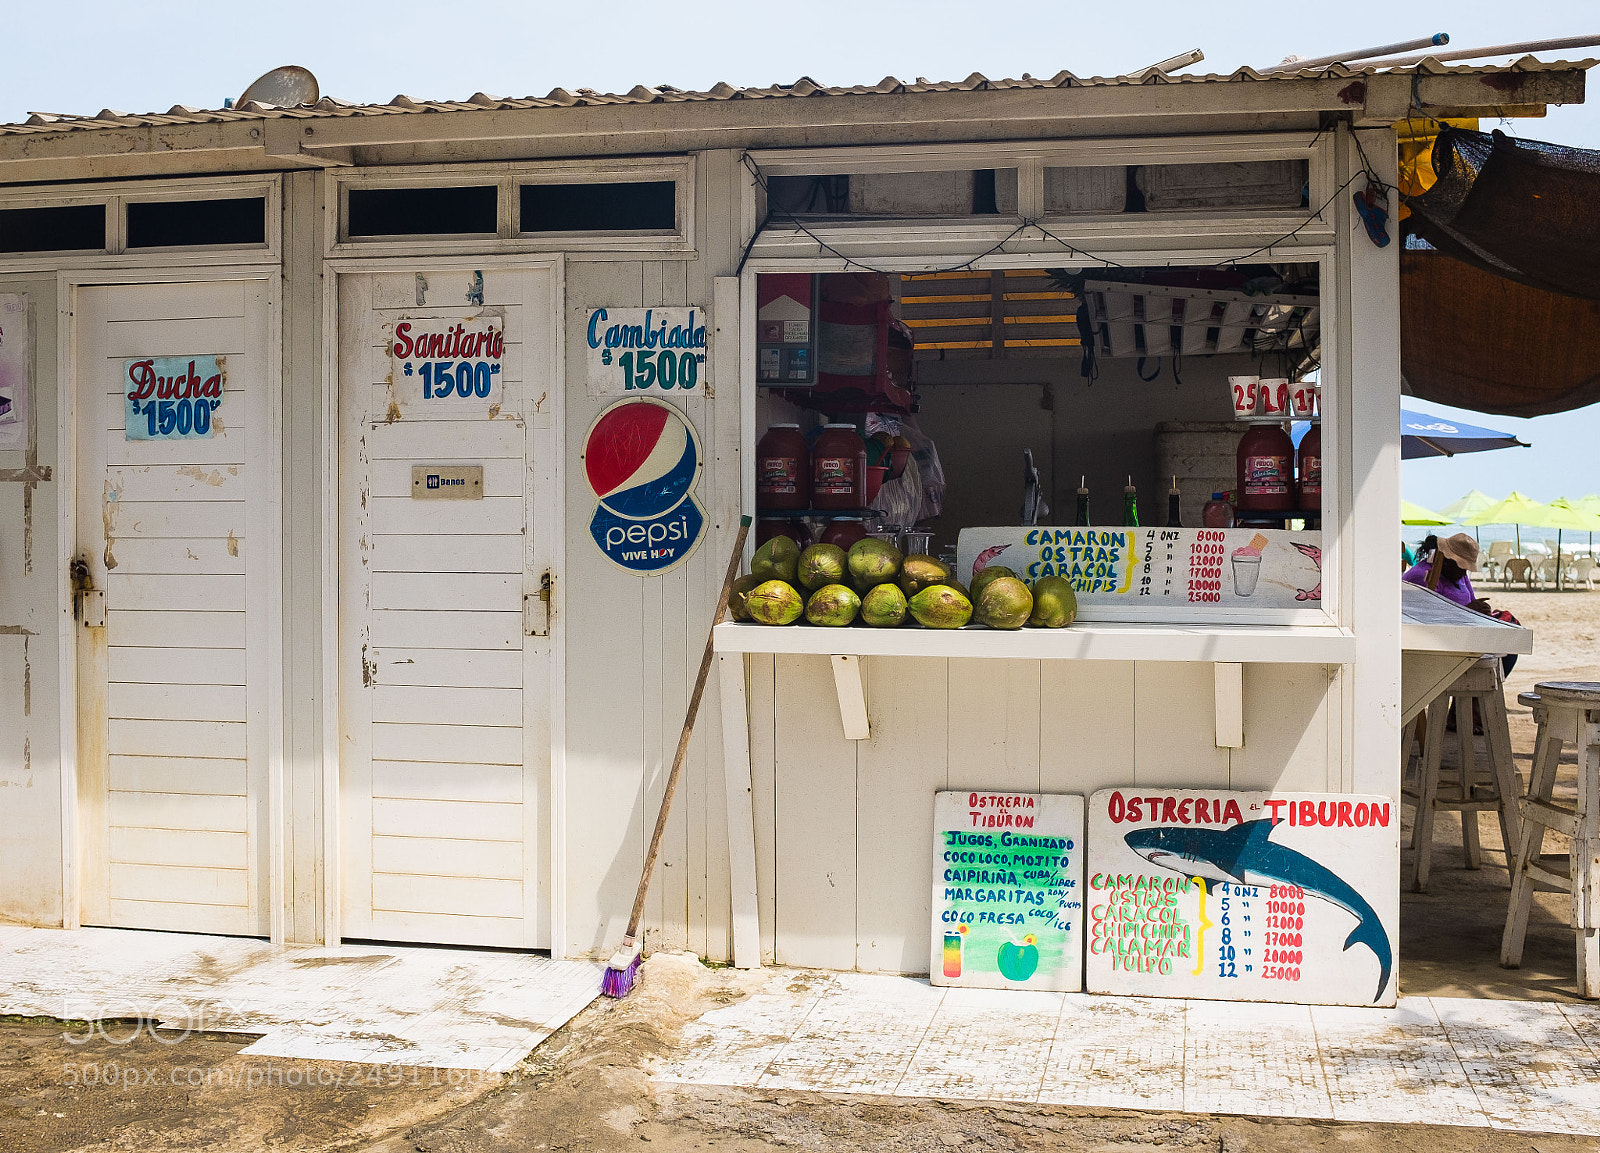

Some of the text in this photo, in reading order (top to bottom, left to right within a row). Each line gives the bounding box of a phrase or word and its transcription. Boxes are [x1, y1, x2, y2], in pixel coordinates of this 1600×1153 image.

[587, 308, 706, 349] Cambiada
[393, 322, 503, 359] Sanitario
[127, 359, 222, 400] Ducha
[1234, 384, 1256, 410] 25
[606, 516, 688, 550] pepsi
[1024, 530, 1126, 548] CAMARON
[1146, 529, 1226, 542] 4 ONZ 8000
[622, 550, 648, 561] VIVE
[1040, 546, 1120, 563] OSTRAS
[1146, 541, 1154, 553] 5
[1190, 543, 1225, 555] 10000
[1144, 553, 1152, 562] 6
[1189, 555, 1223, 566] 12000
[1026, 562, 1118, 579] CARACOL
[1143, 562, 1151, 573] 8
[1189, 567, 1222, 578] 17000
[1140, 576, 1151, 585] 10
[1139, 587, 1151, 596] 12
[1187, 591, 1221, 602] 25000
[968, 792, 1034, 808] OSTRERIA
[1108, 790, 1243, 825] OSTRERIA
[1263, 799, 1390, 828] TIBURON
[969, 811, 1034, 828] TIBURON
[946, 830, 1074, 850] JUGOS, GRANIZADO
[943, 851, 976, 864] COCO
[1012, 854, 1069, 868] MOJITO
[1090, 873, 1191, 894] CAMARON
[1221, 881, 1304, 900] 4 ONZ 8000
[944, 888, 1045, 906] MARGARITAS
[1109, 889, 1178, 907] OSTRAS
[1091, 904, 1188, 923] CARACOL
[1221, 897, 1230, 911] 5
[1265, 900, 1305, 916] 10000
[941, 910, 975, 923] COCO
[979, 911, 1025, 924] FRESA
[1221, 912, 1230, 926] 6
[1265, 915, 1303, 930] 12000
[1221, 927, 1231, 945] 8
[1264, 931, 1303, 947] 17000
[1090, 937, 1192, 958] CALAMAR
[1218, 945, 1236, 961] 10
[1263, 948, 1303, 965] 20000
[1112, 955, 1173, 975] PULPO
[1218, 962, 1238, 977] 12
[1261, 965, 1301, 981] 25000
